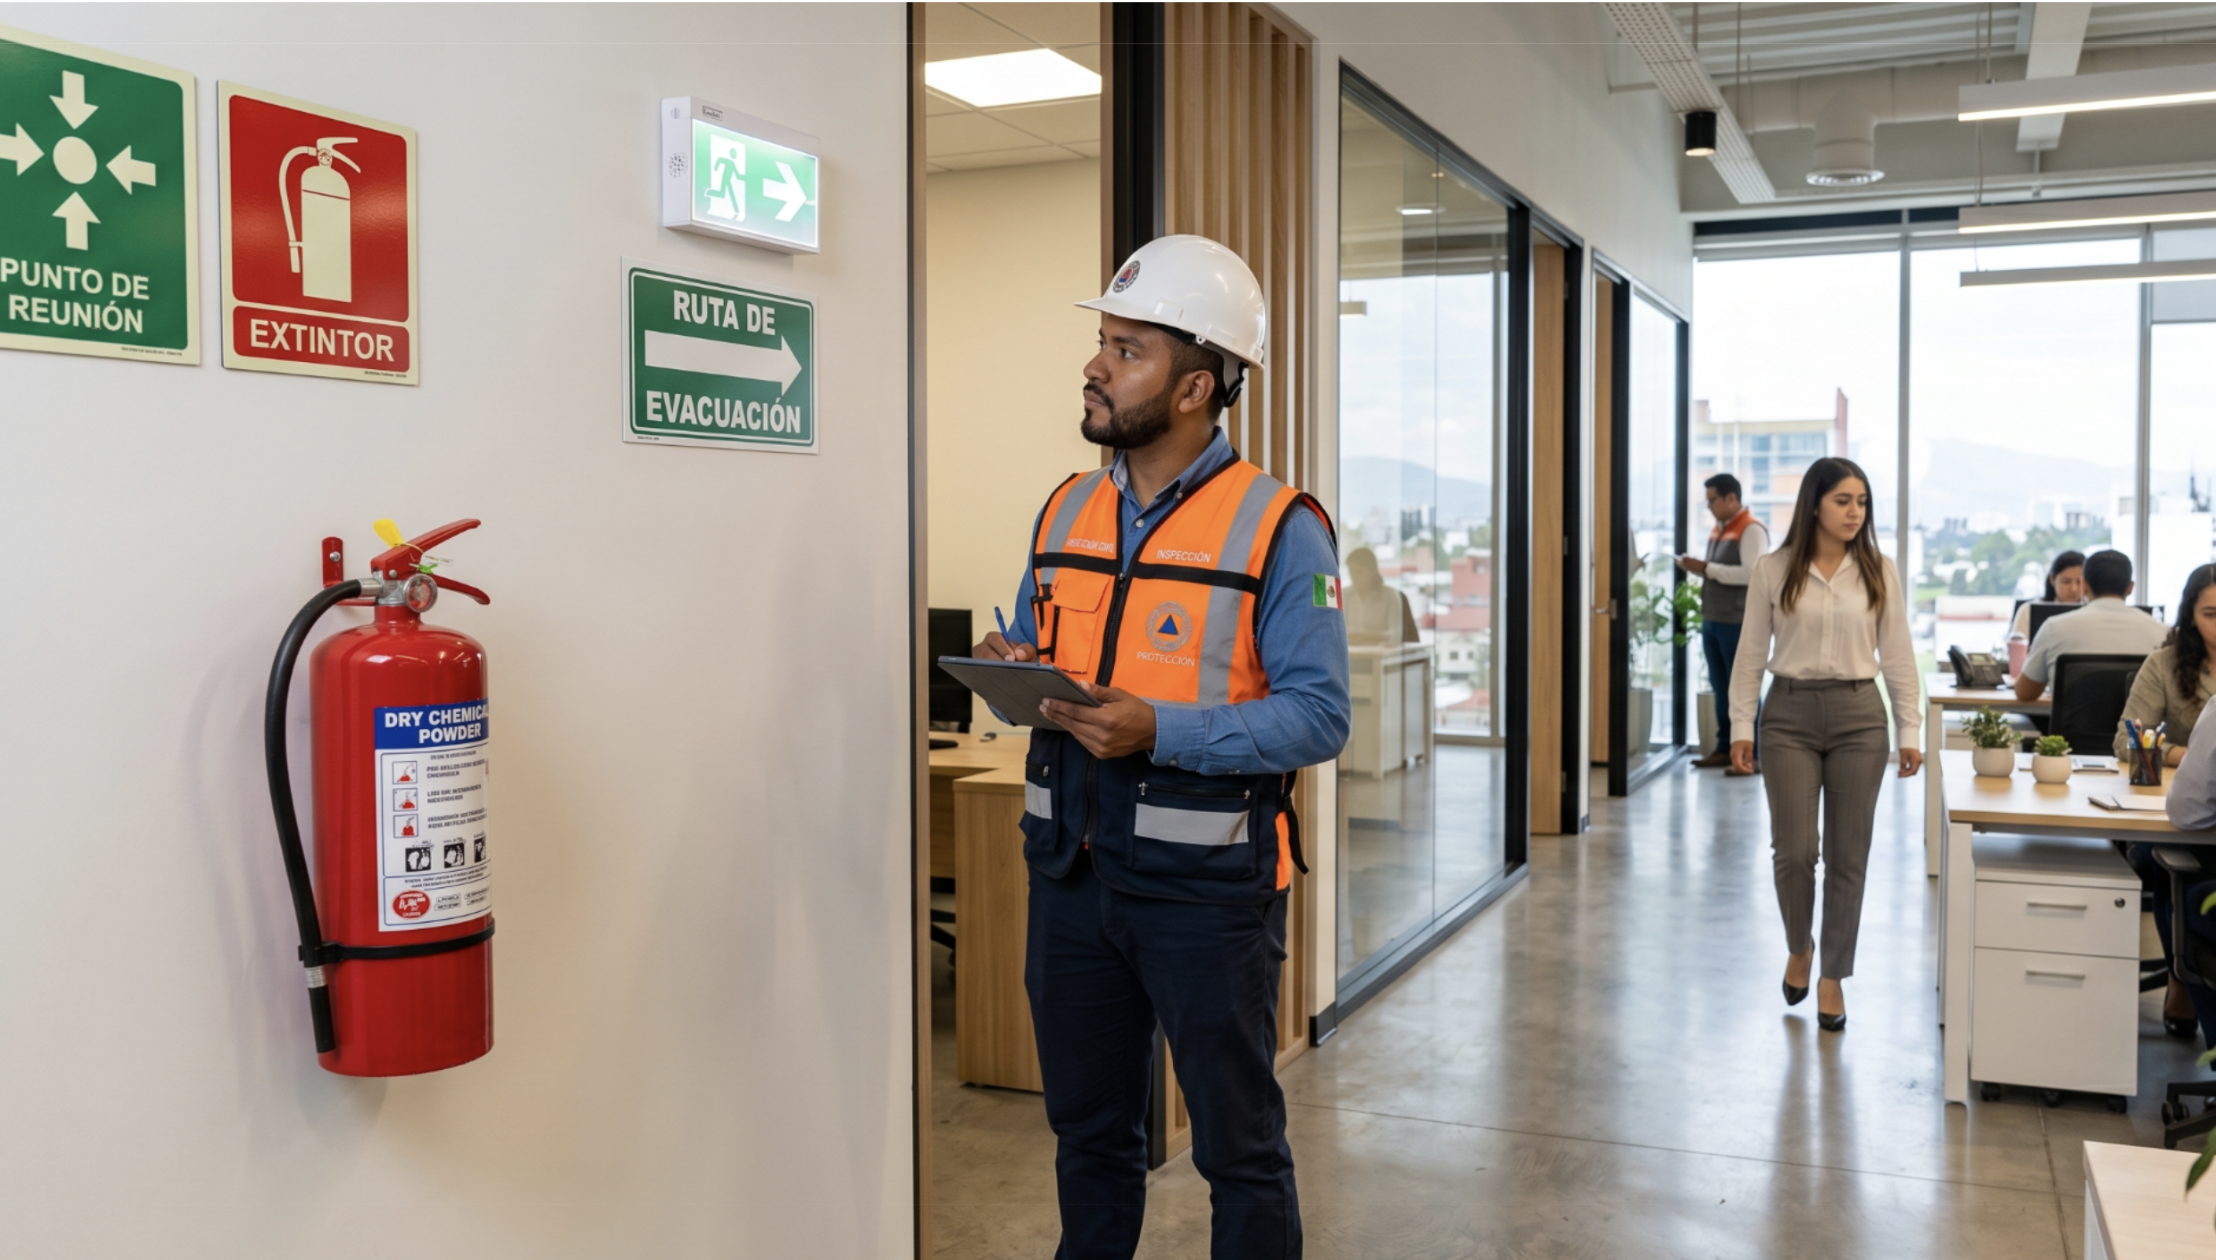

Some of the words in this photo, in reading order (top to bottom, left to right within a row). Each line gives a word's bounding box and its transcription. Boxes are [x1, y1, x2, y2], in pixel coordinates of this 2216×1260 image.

[1, 256, 104, 294] PUNTO
[112, 271, 150, 300] DE
[9, 294, 143, 334] REUNIÓN
[673, 289, 739, 330] RUTA
[746, 302, 776, 336] DE
[250, 318, 395, 362] EXTINTOR
[646, 389, 801, 434] EVACUACIÓN
[1156, 549, 1211, 563] INSPECCIÓN
[1136, 650, 1195, 667] PROTECCIÓN
[385, 711, 424, 728] DRY
[428, 704, 489, 726] CHEMICA
[418, 722, 481, 744] POWDER
